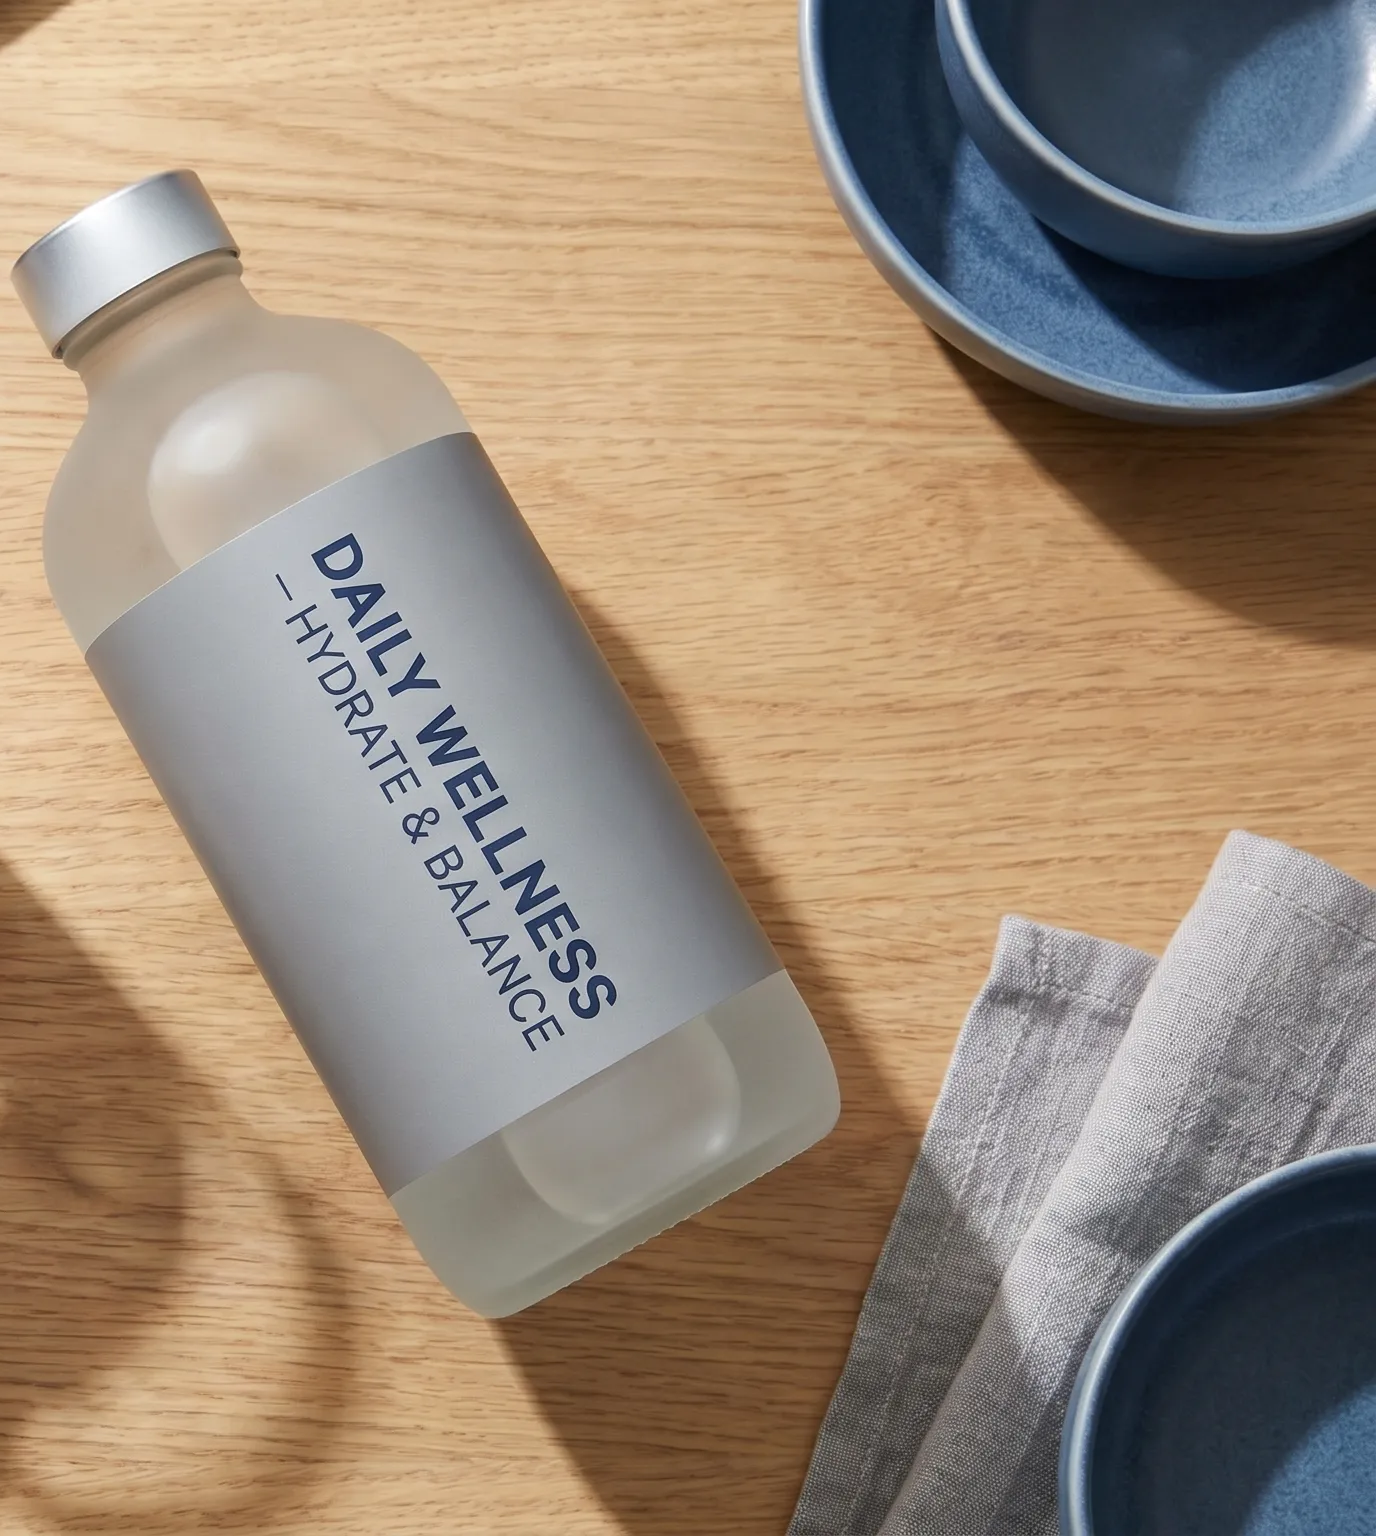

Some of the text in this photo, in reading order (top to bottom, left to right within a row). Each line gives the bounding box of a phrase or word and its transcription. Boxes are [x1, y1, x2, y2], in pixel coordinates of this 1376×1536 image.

[284, 603, 422, 805] HYDRATE
[401, 807, 441, 845] &
[423, 844, 566, 1052] BALANCE
[310, 532, 618, 1020] DAILY WELLNESS
